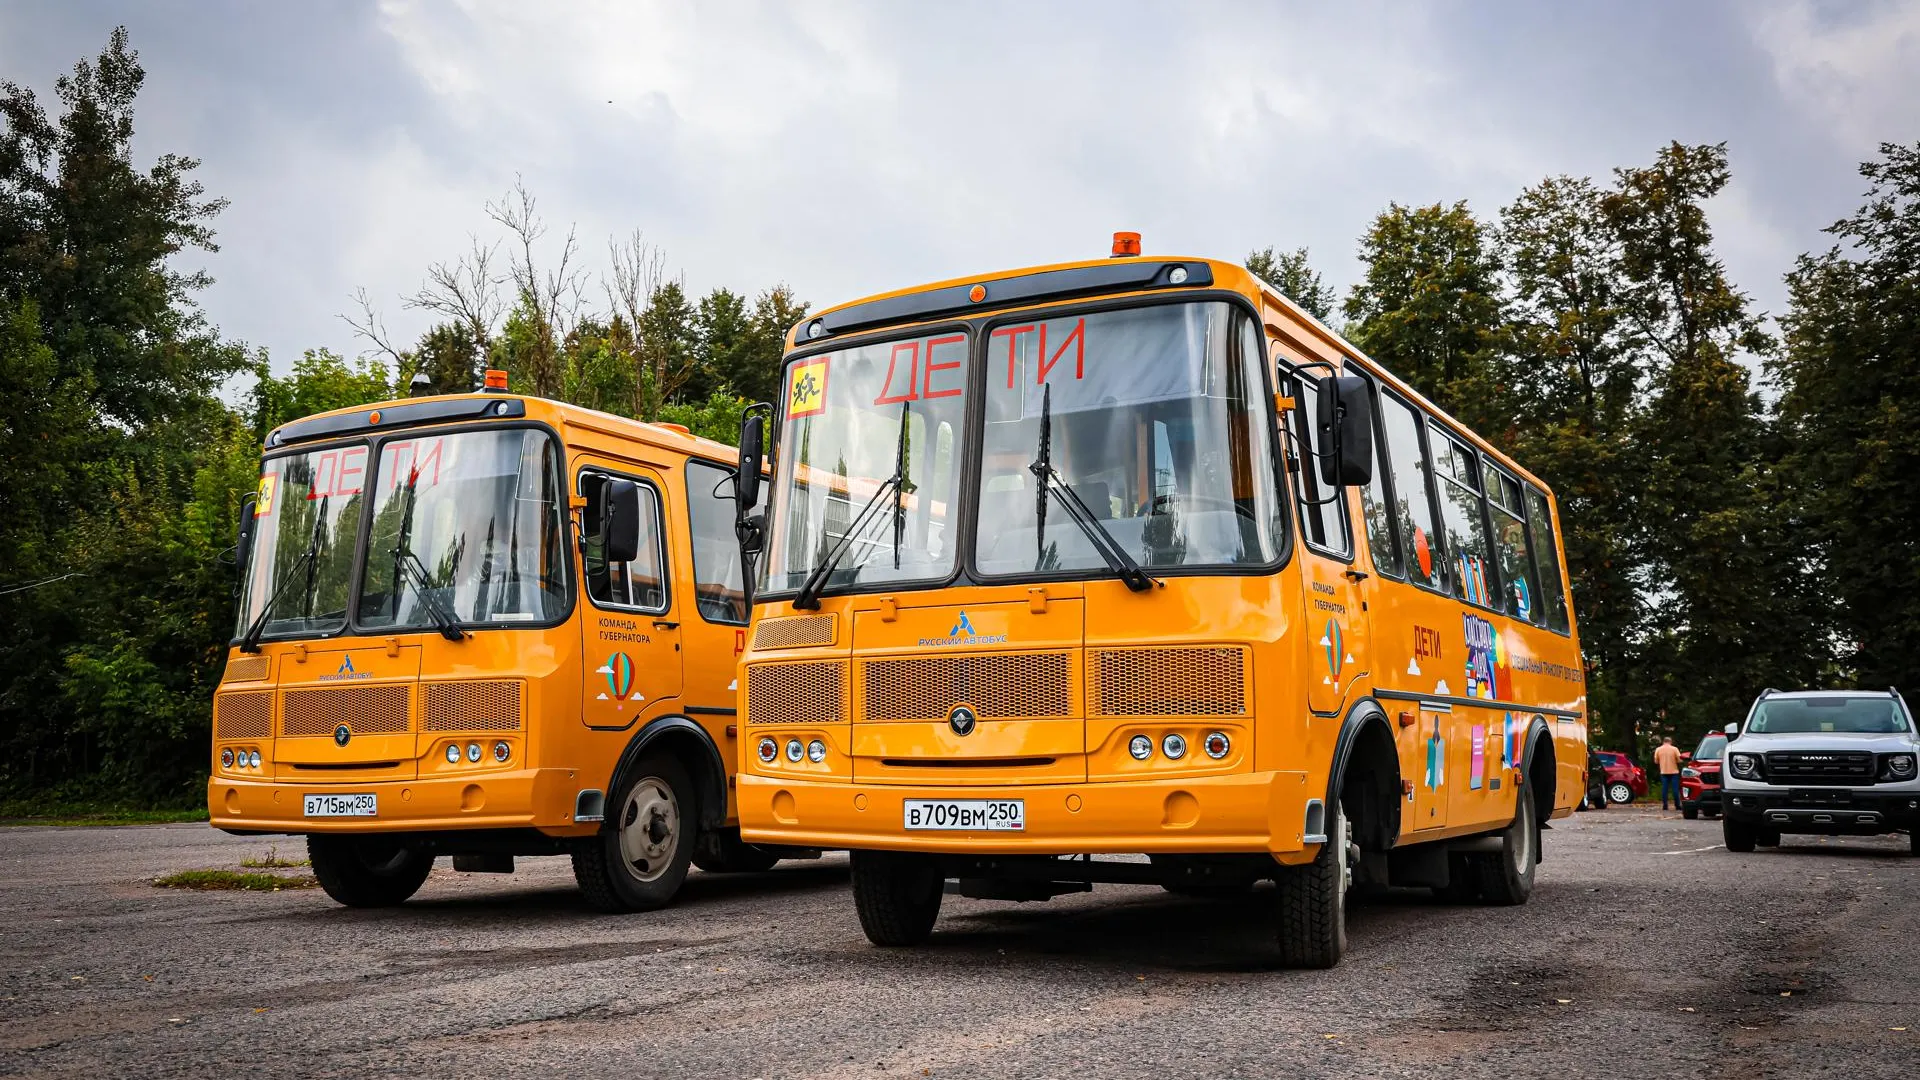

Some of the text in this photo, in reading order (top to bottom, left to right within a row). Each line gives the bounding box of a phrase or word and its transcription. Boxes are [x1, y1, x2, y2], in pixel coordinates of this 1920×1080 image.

[1312, 581, 1335, 596] КОМАНДА
[1314, 599, 1346, 614] ГУБЕРНАТОРА
[599, 617, 637, 631] КОМАНДА
[599, 631, 651, 644] ГУБЕРНАТОРА
[918, 634, 1007, 646] РУССКИЙ АВТОБУС
[1414, 624, 1442, 661] ДЕТИ
[355, 796, 373, 809] 250
[988, 803, 1013, 820] 250
[995, 820, 1011, 828] RUS
